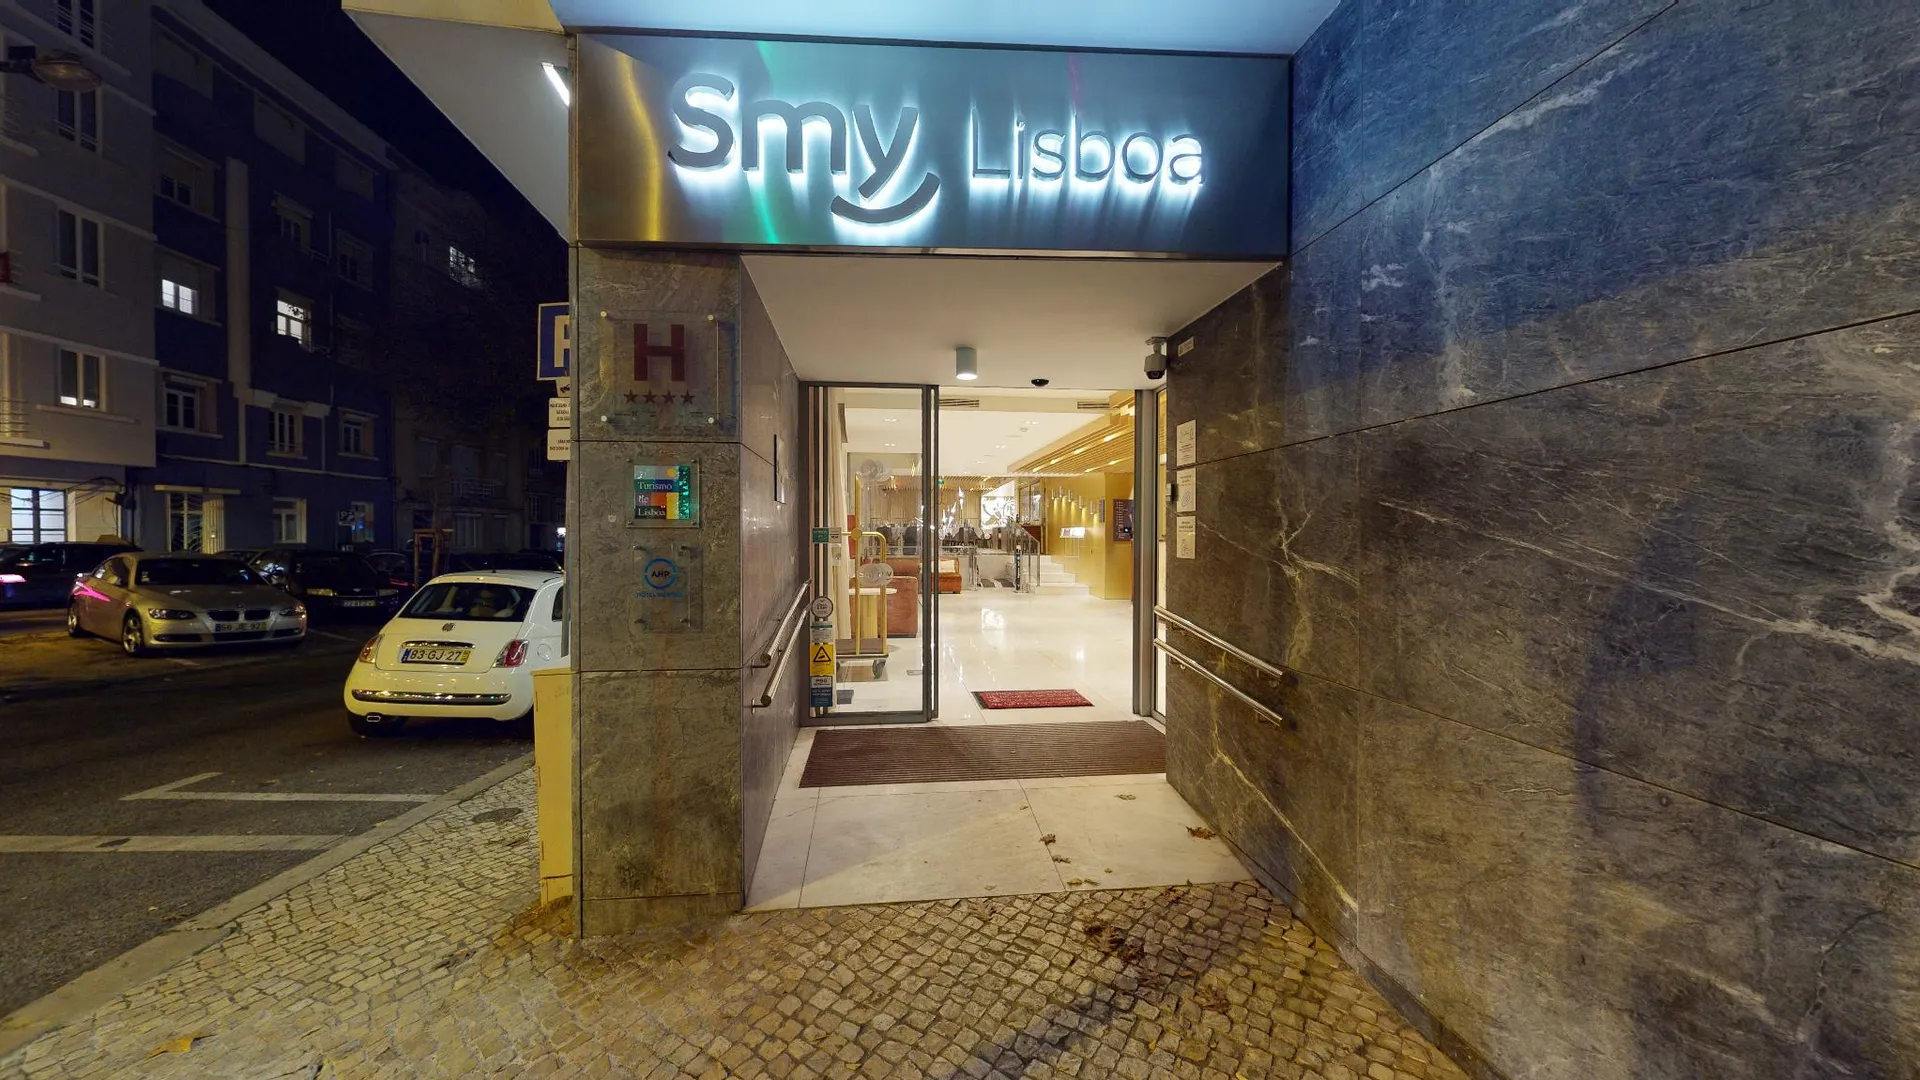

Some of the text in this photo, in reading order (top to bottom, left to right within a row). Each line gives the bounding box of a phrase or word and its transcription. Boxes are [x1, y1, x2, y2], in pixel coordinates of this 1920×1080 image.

[668, 72, 1205, 224] Smy Lisboa
[633, 323, 685, 381] H
[638, 481, 673, 490] Turismo
